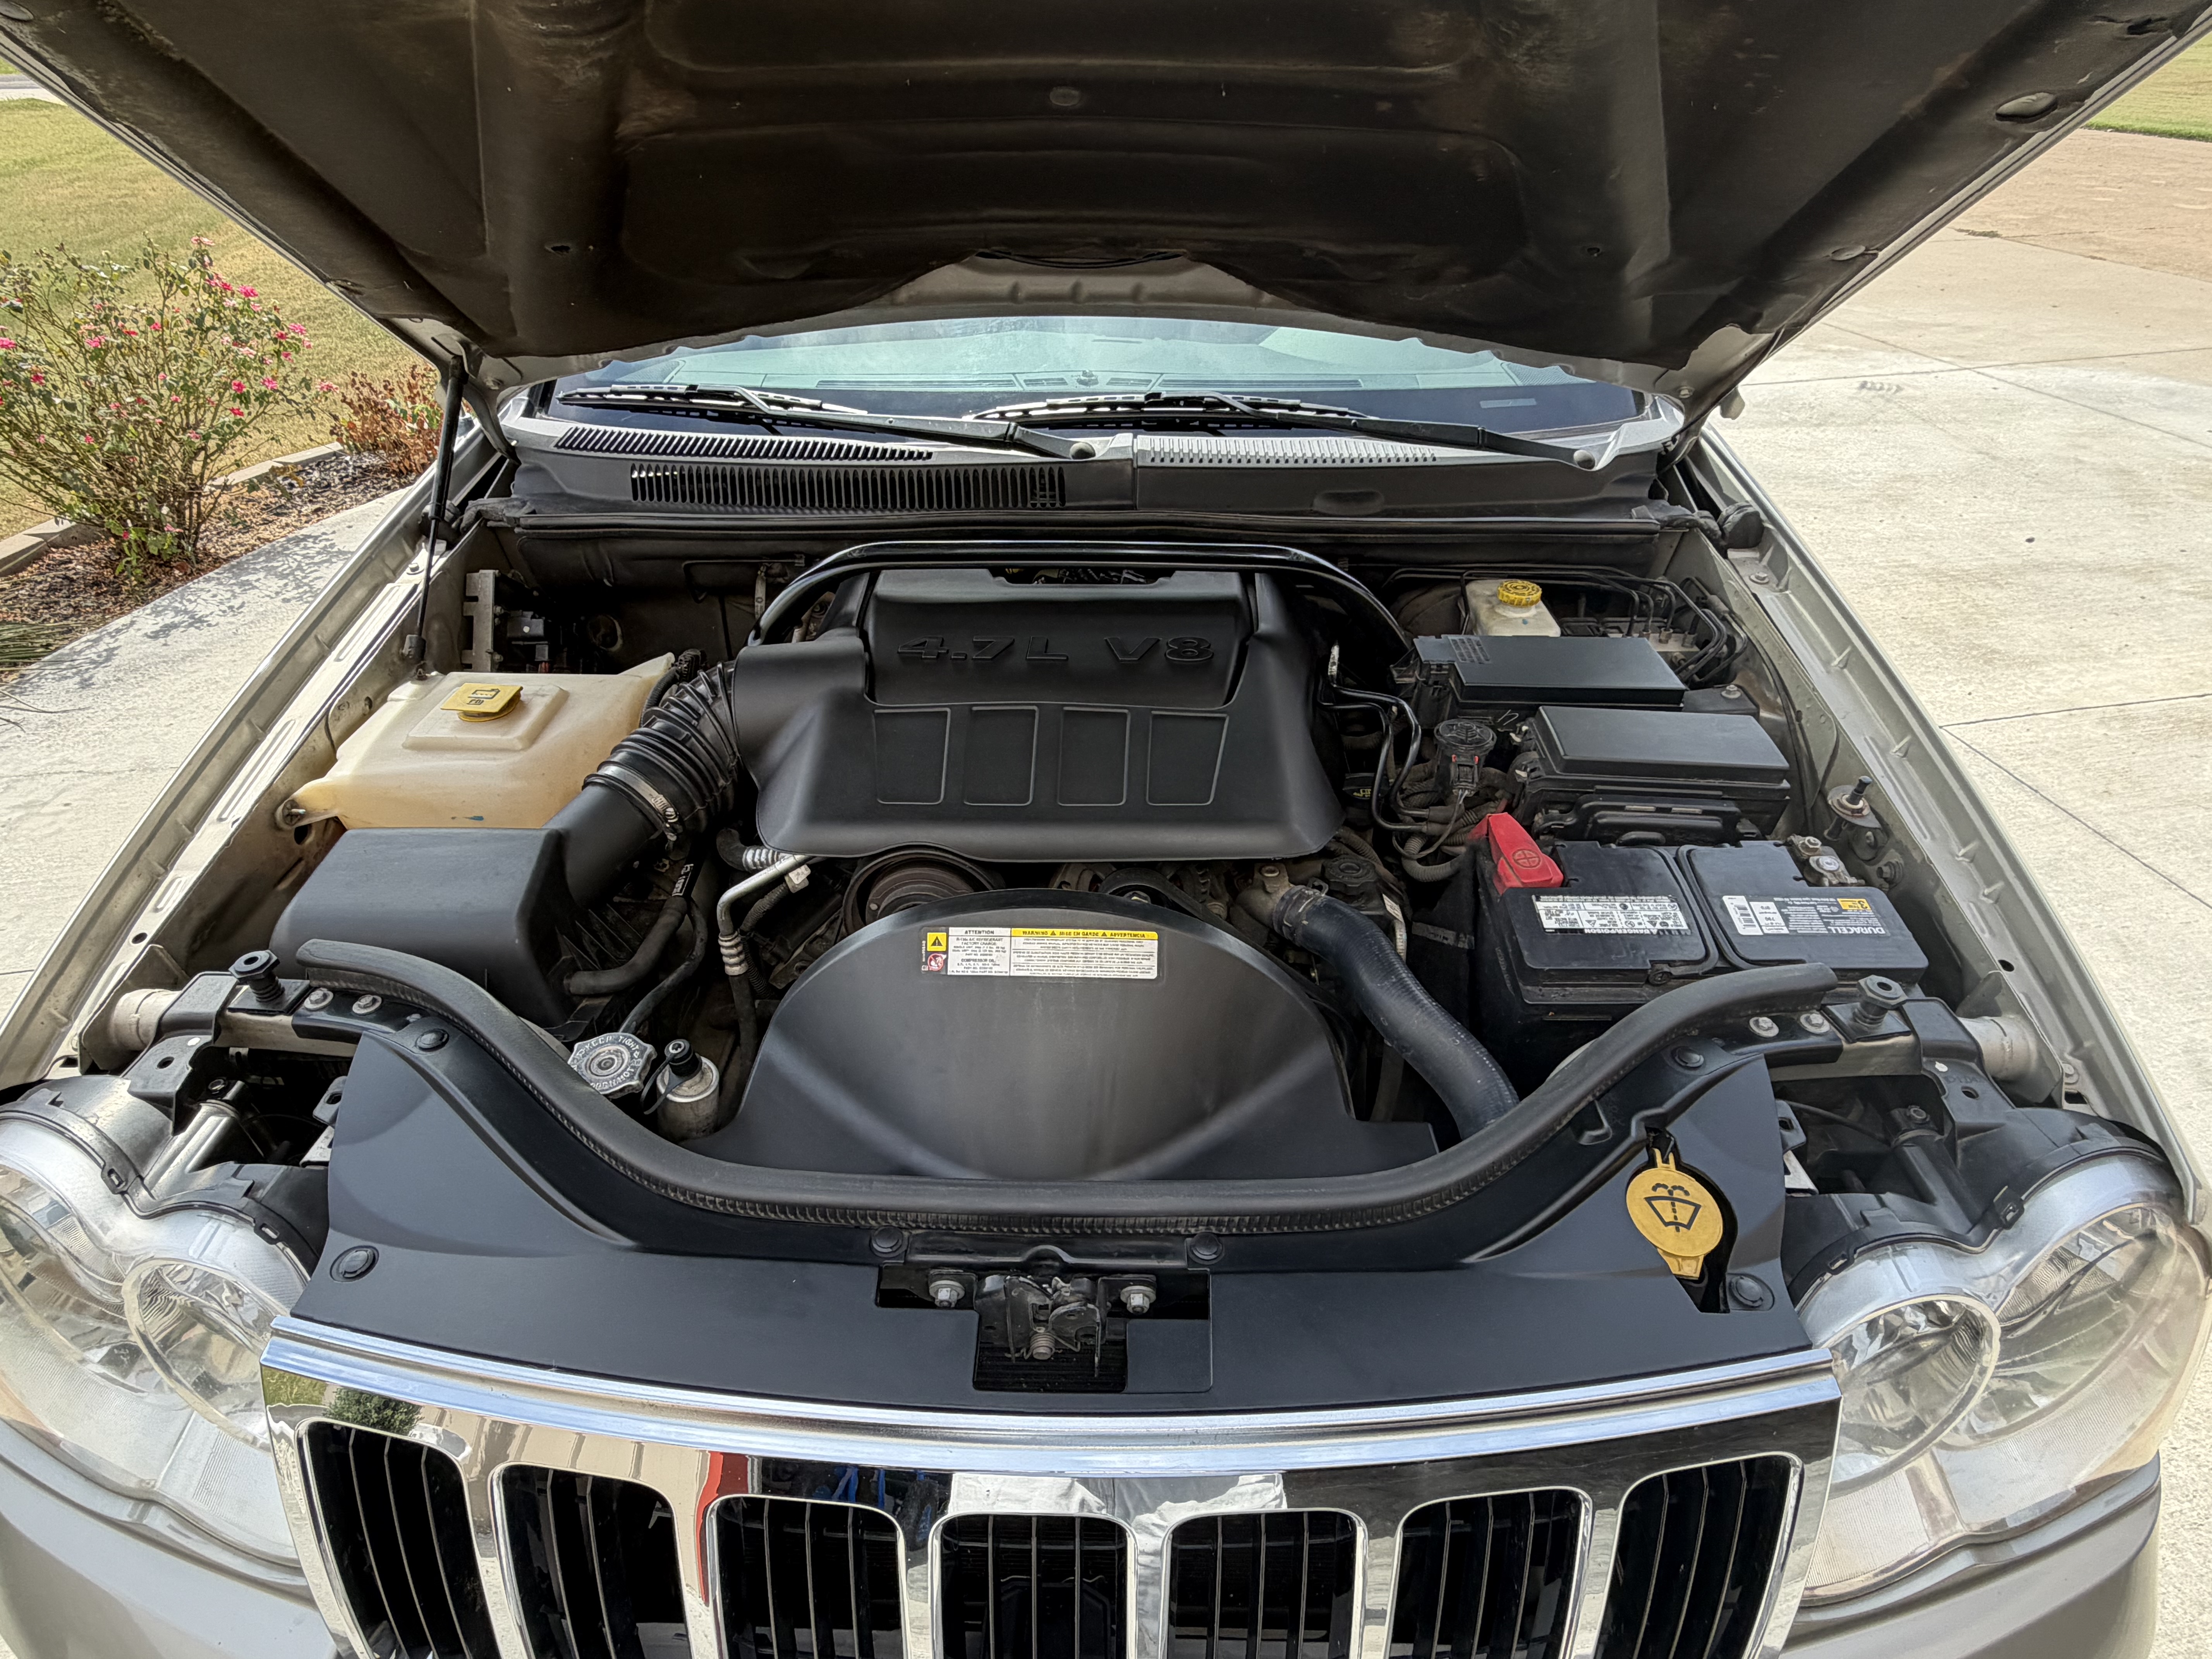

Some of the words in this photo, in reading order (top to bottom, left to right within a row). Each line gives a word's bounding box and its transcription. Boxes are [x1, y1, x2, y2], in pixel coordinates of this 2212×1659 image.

[897, 635, 1069, 663] 4.7L
[1104, 635, 1214, 663] V8
[1858, 900, 1868, 909] 3
[618, 1036, 640, 1051] TIGHT
